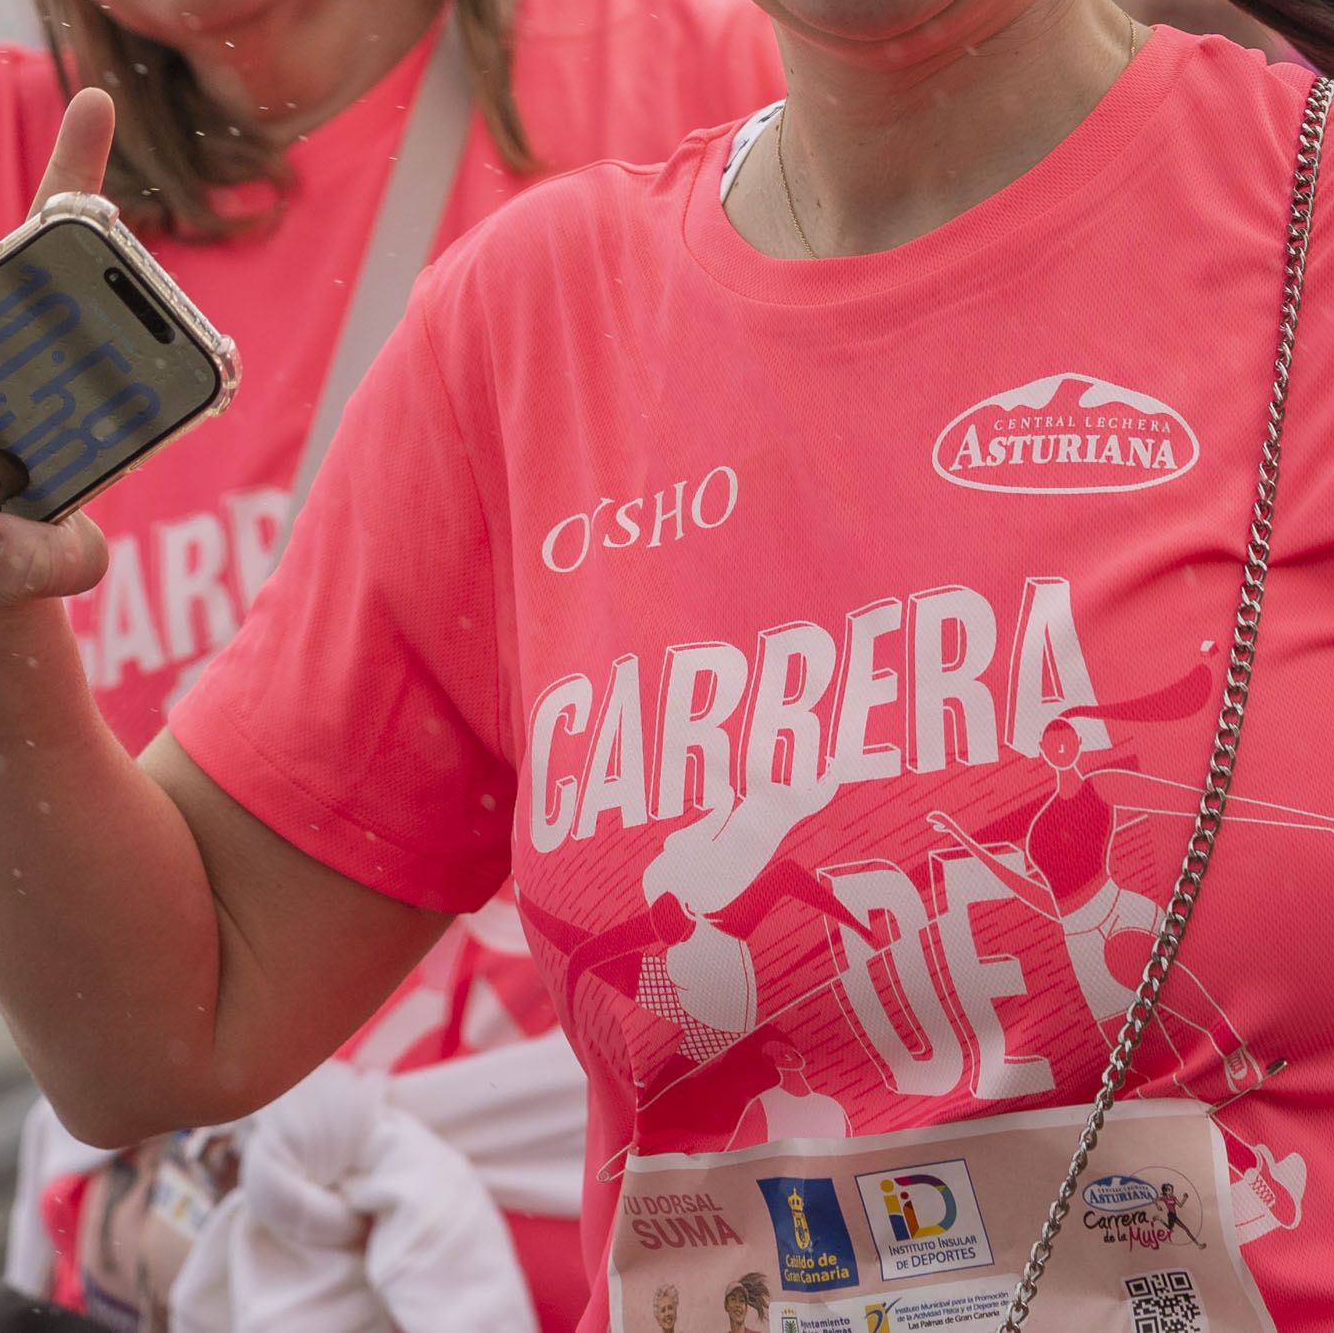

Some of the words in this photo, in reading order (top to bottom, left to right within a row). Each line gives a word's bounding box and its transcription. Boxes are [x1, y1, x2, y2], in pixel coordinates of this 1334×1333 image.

[994, 416, 1077, 431] CENTRAL
[1085, 416, 1172, 434] LECHERA
[949, 423, 1178, 471] ASTURIANA
[527, 576, 1113, 853] CARRERA
[816, 842, 1055, 1099] DE
[642, 1193, 723, 1215] DORSAL
[1089, 1189, 1155, 1204] ASTURIANA
[1083, 1210, 1149, 1231] Carrera
[631, 1215, 744, 1250] SUMA
[1103, 1229, 1116, 1243] de
[1129, 1220, 1174, 1252] Mujer
[888, 1240, 936, 1256] INSTITUTO
[937, 1235, 977, 1248] INSULAR
[785, 1253, 815, 1269] Cabildo
[817, 1253, 837, 1267] de
[911, 1247, 976, 1268] DEPORTES
[801, 1266, 850, 1284] Canaria
[895, 1306, 920, 1315] Instituto
[951, 1298, 967, 1308] para
[973, 1300, 999, 1311] Deporte
[908, 1321, 921, 1330] Las
[920, 1318, 944, 1329] Palmas
[945, 1316, 955, 1325] de
[954, 1313, 973, 1324] Gran
[973, 1309, 1000, 1320] Canaria
